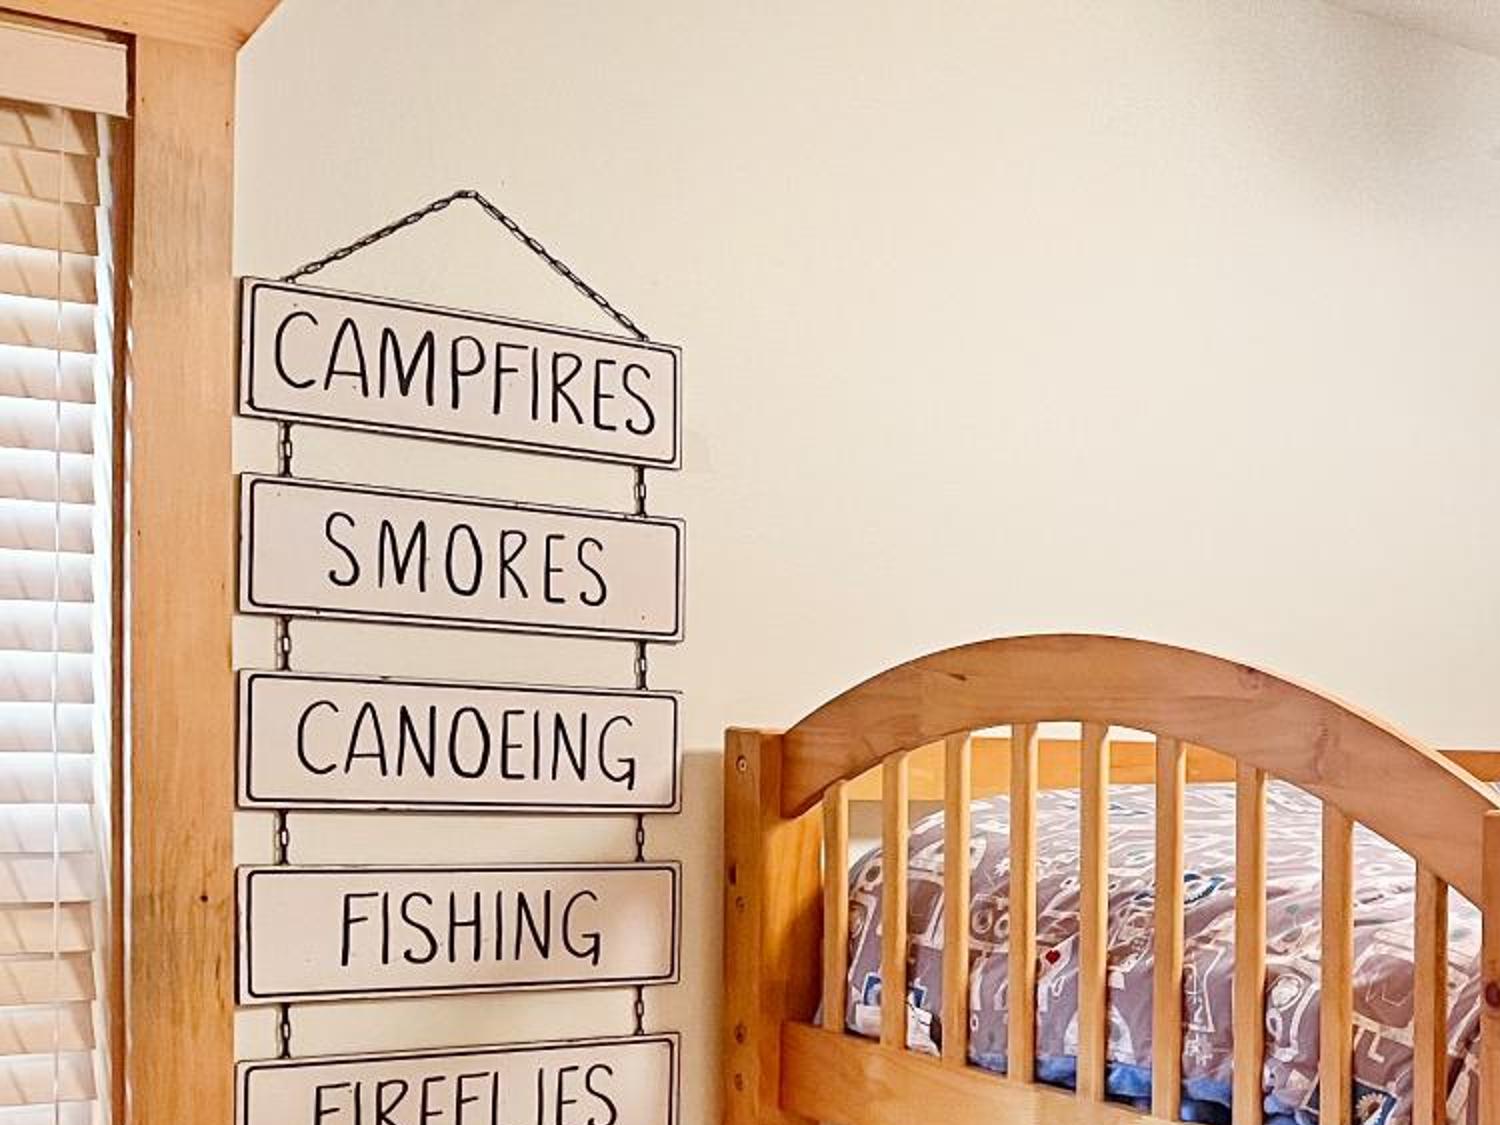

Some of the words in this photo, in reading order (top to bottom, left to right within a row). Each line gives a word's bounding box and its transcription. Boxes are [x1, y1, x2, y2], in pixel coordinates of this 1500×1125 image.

[274, 311, 655, 436] CAMPFIRES
[325, 511, 607, 607] SMORES
[297, 700, 635, 791] CANOEING
[341, 889, 601, 967] FISHING
